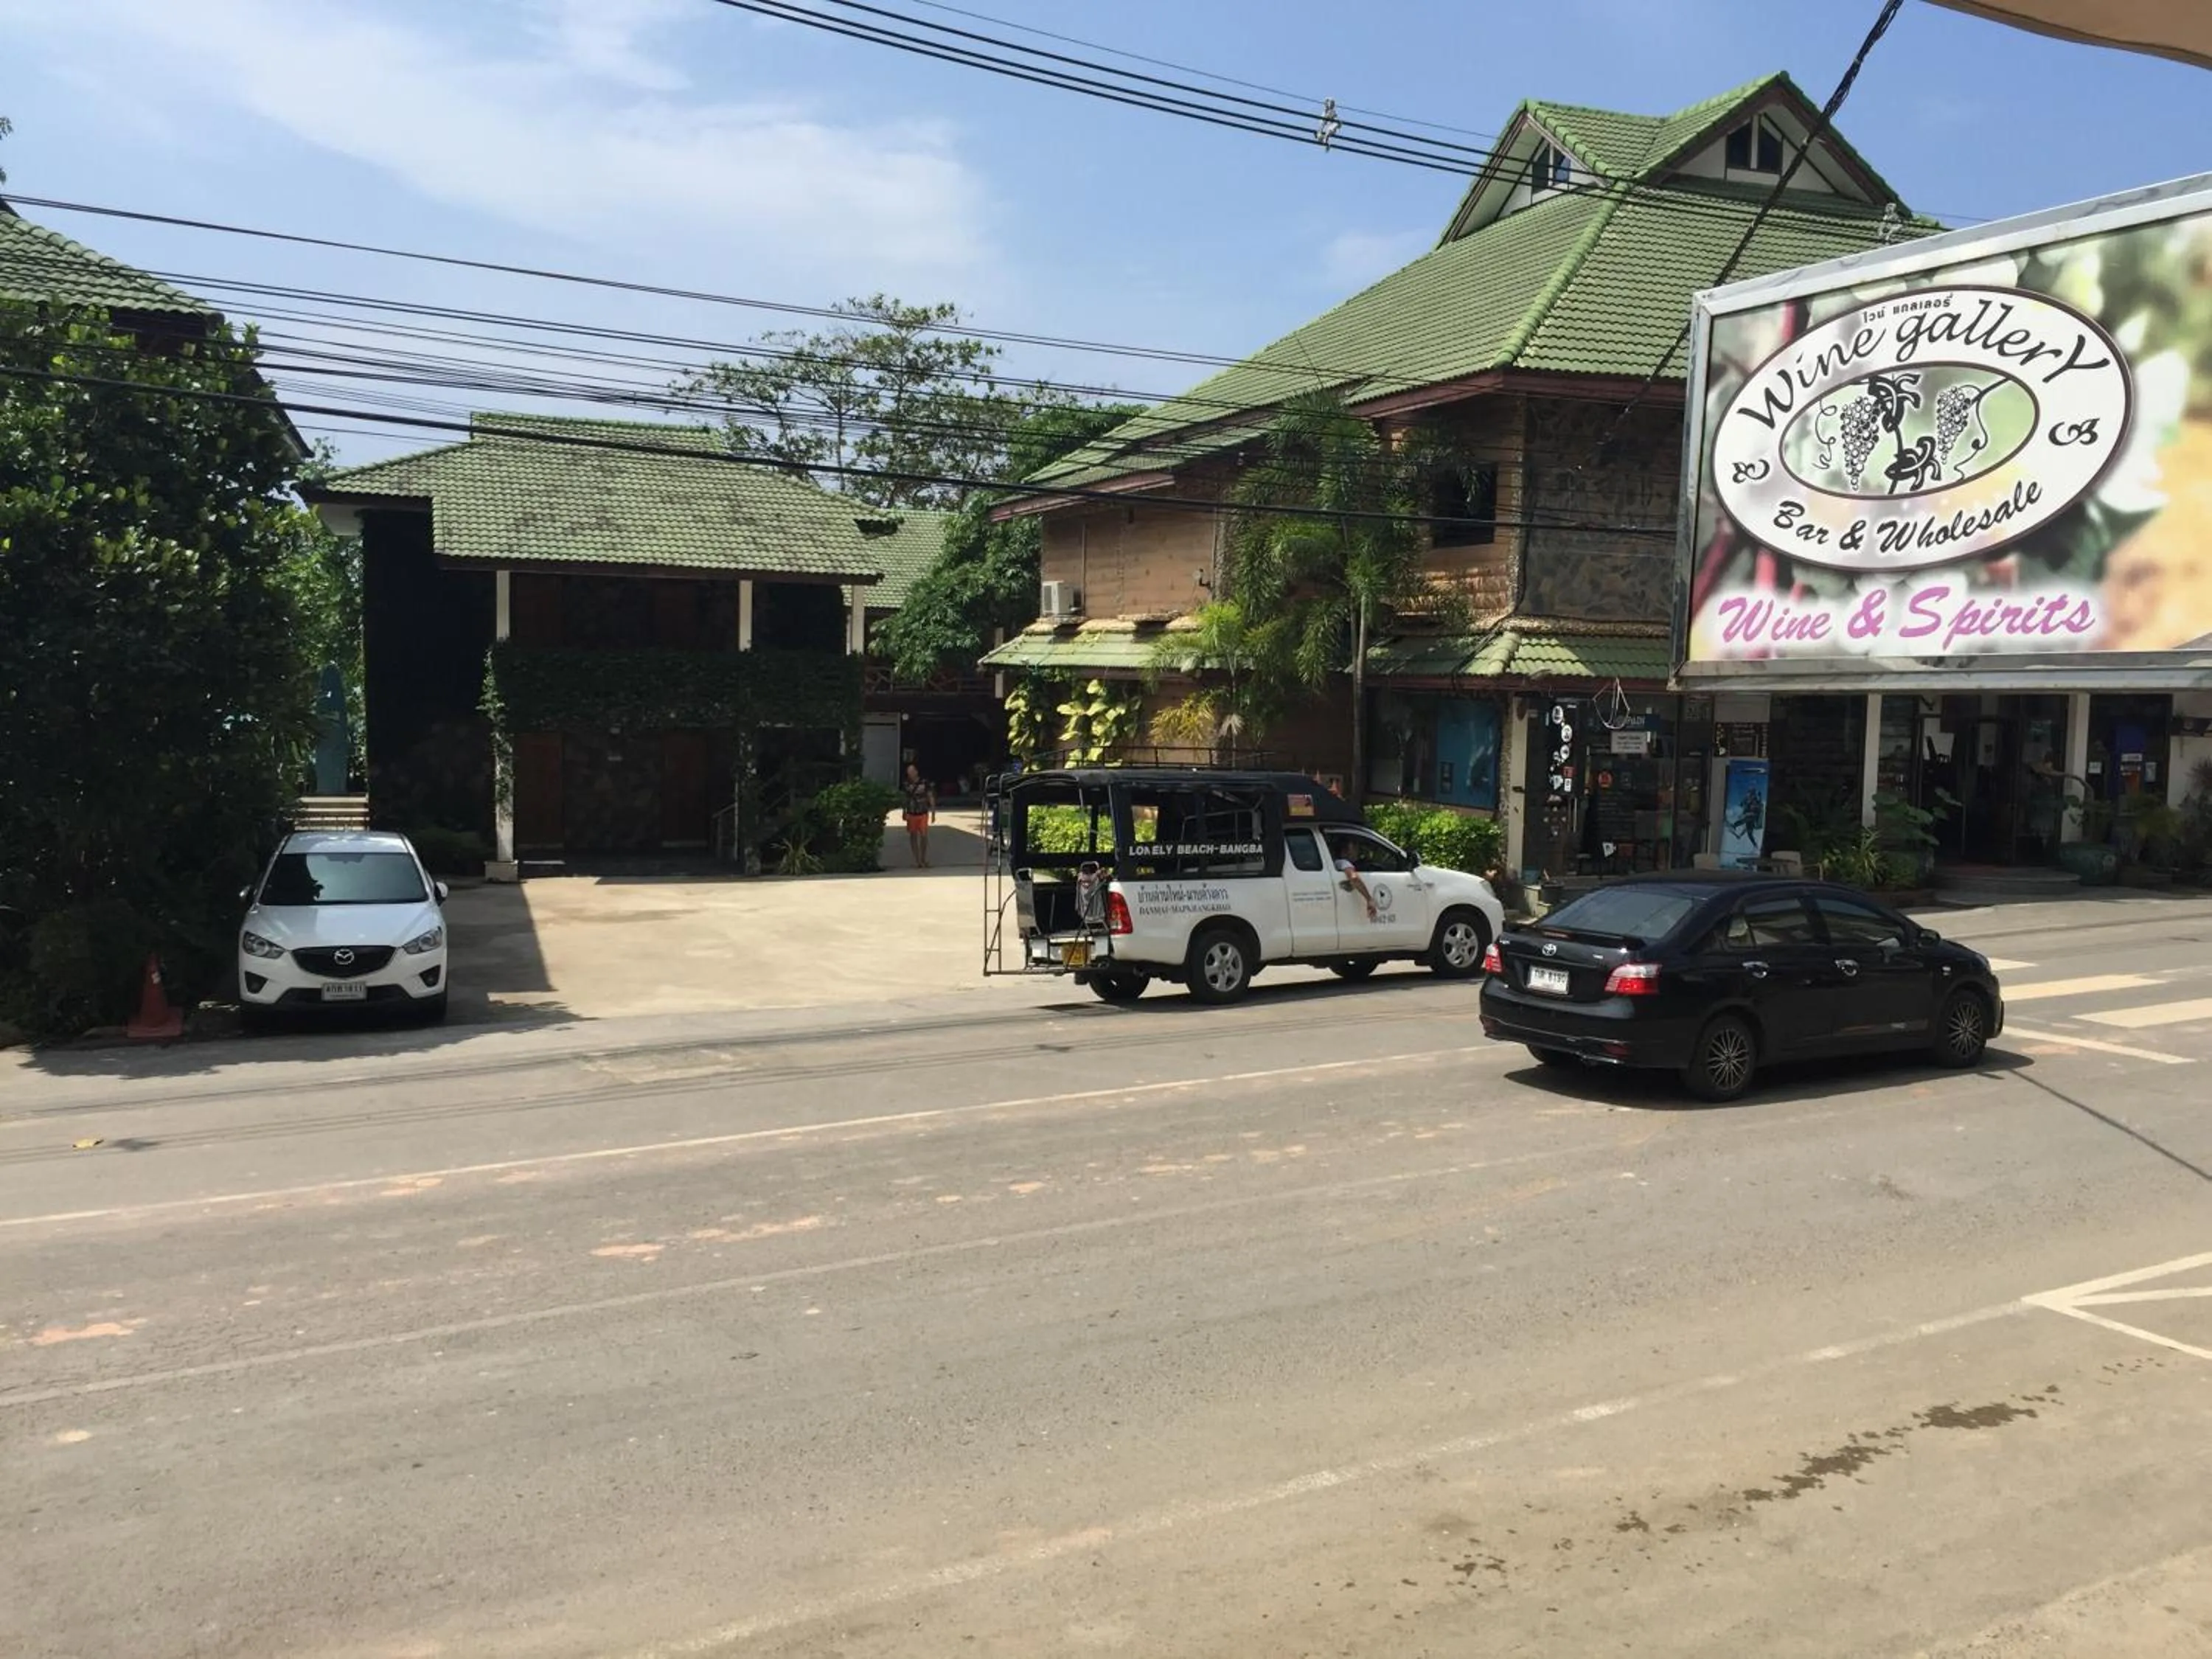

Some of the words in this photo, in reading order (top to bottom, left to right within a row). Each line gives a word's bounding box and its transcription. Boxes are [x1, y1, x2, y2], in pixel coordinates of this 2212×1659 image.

[1863, 306, 1886, 324] ไวน์
[1736, 327, 1887, 430] Wine
[1773, 499, 1829, 545] Bar
[1839, 518, 1867, 551] &
[1876, 480, 2043, 553] Wholesale
[1718, 595, 1832, 643] Wine
[1846, 588, 1888, 639] &
[1898, 585, 2096, 650] Spirits
[1128, 844, 1174, 857] LONELY
